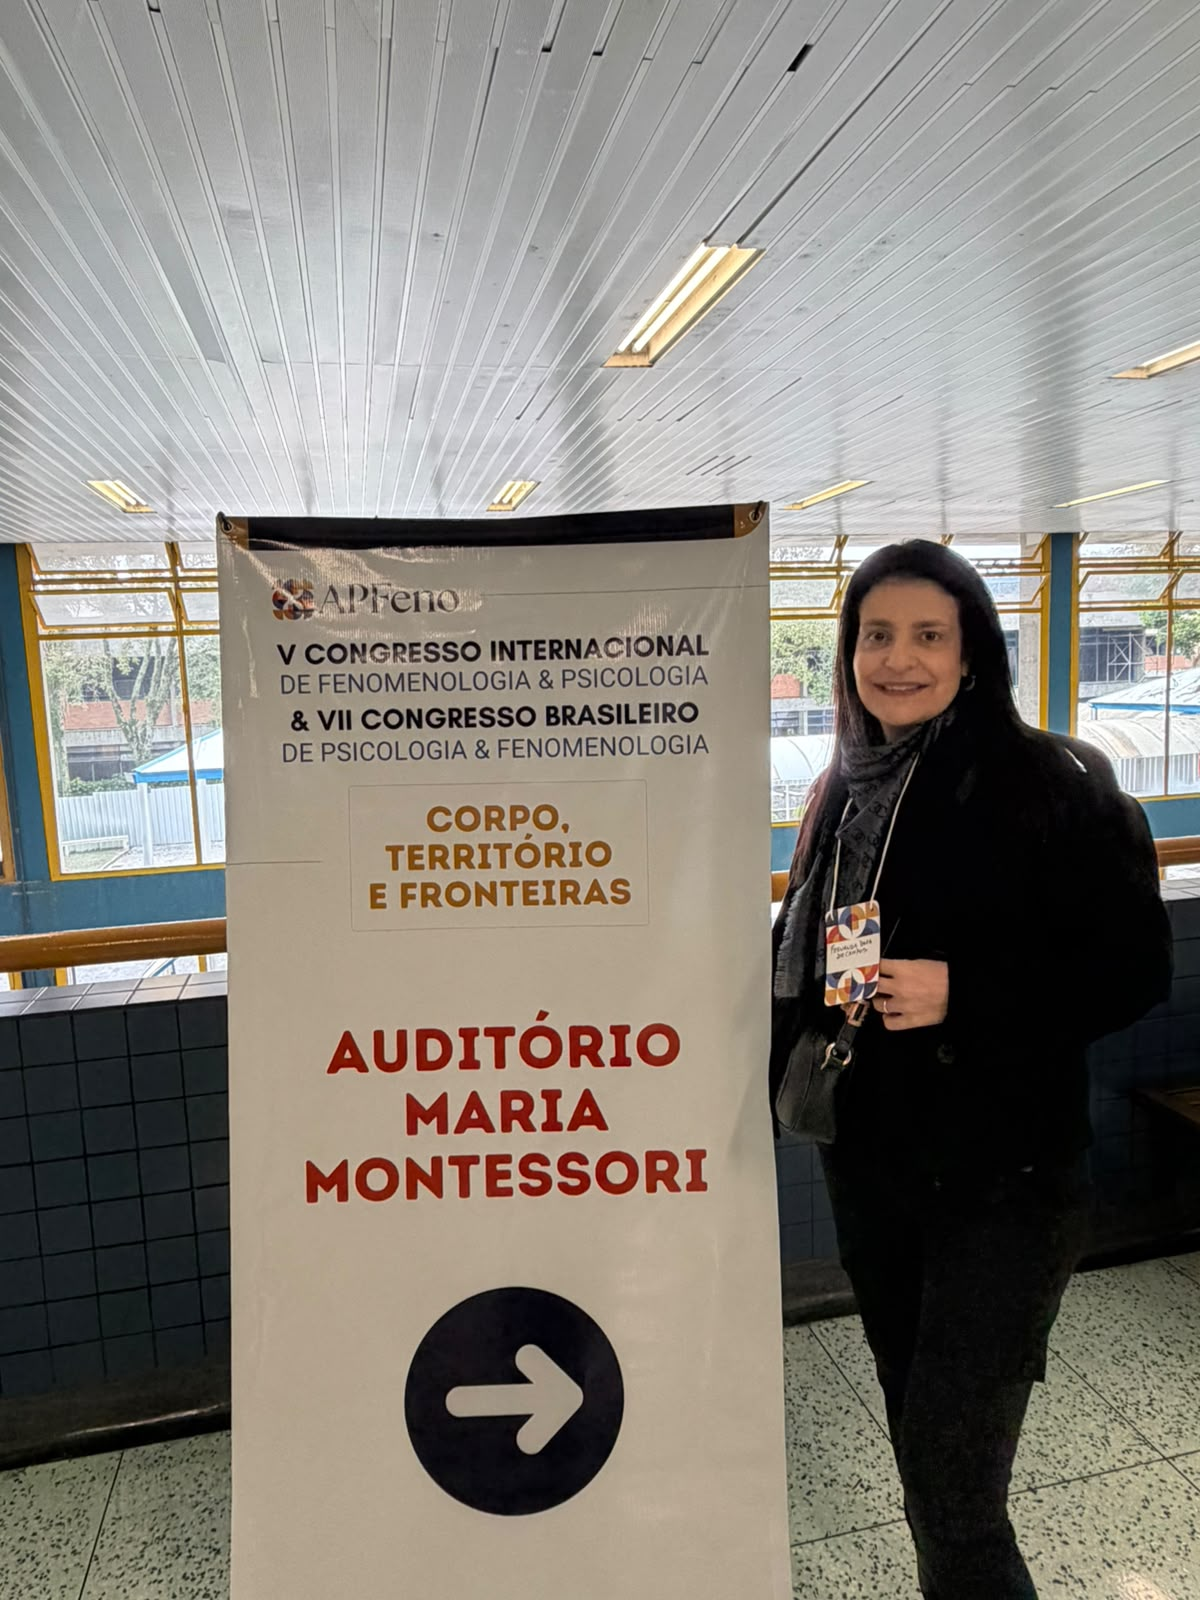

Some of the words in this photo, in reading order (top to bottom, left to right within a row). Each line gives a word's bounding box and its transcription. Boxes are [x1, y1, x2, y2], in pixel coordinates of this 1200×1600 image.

[318, 583, 460, 614] APFeno
[276, 643, 297, 666] V
[304, 640, 482, 666] CONGRESSO
[490, 634, 710, 662] INTERNACIONAL
[280, 674, 312, 695] DE
[318, 670, 532, 694] FENOMENOLOGIA
[538, 669, 555, 691] &
[561, 665, 709, 689] PSICOLOGIA
[290, 709, 310, 732] &
[316, 709, 353, 732] VII
[360, 705, 537, 731] CONGRESSO
[545, 701, 700, 727] BRASILEIRO
[282, 742, 314, 763] DE
[321, 740, 468, 763] PSICOLOGIA
[474, 738, 491, 760] &
[497, 733, 710, 759] FENOMENOLOGIA
[426, 803, 570, 835] CORPO,
[385, 833, 613, 872] TERRITÓRIO
[369, 882, 388, 910] E
[399, 877, 632, 910] FRONTEIRAS
[326, 1009, 681, 1075] AUDITÓRIO
[405, 1087, 610, 1137] MARIA
[305, 1148, 708, 1204] MONTESSORI
